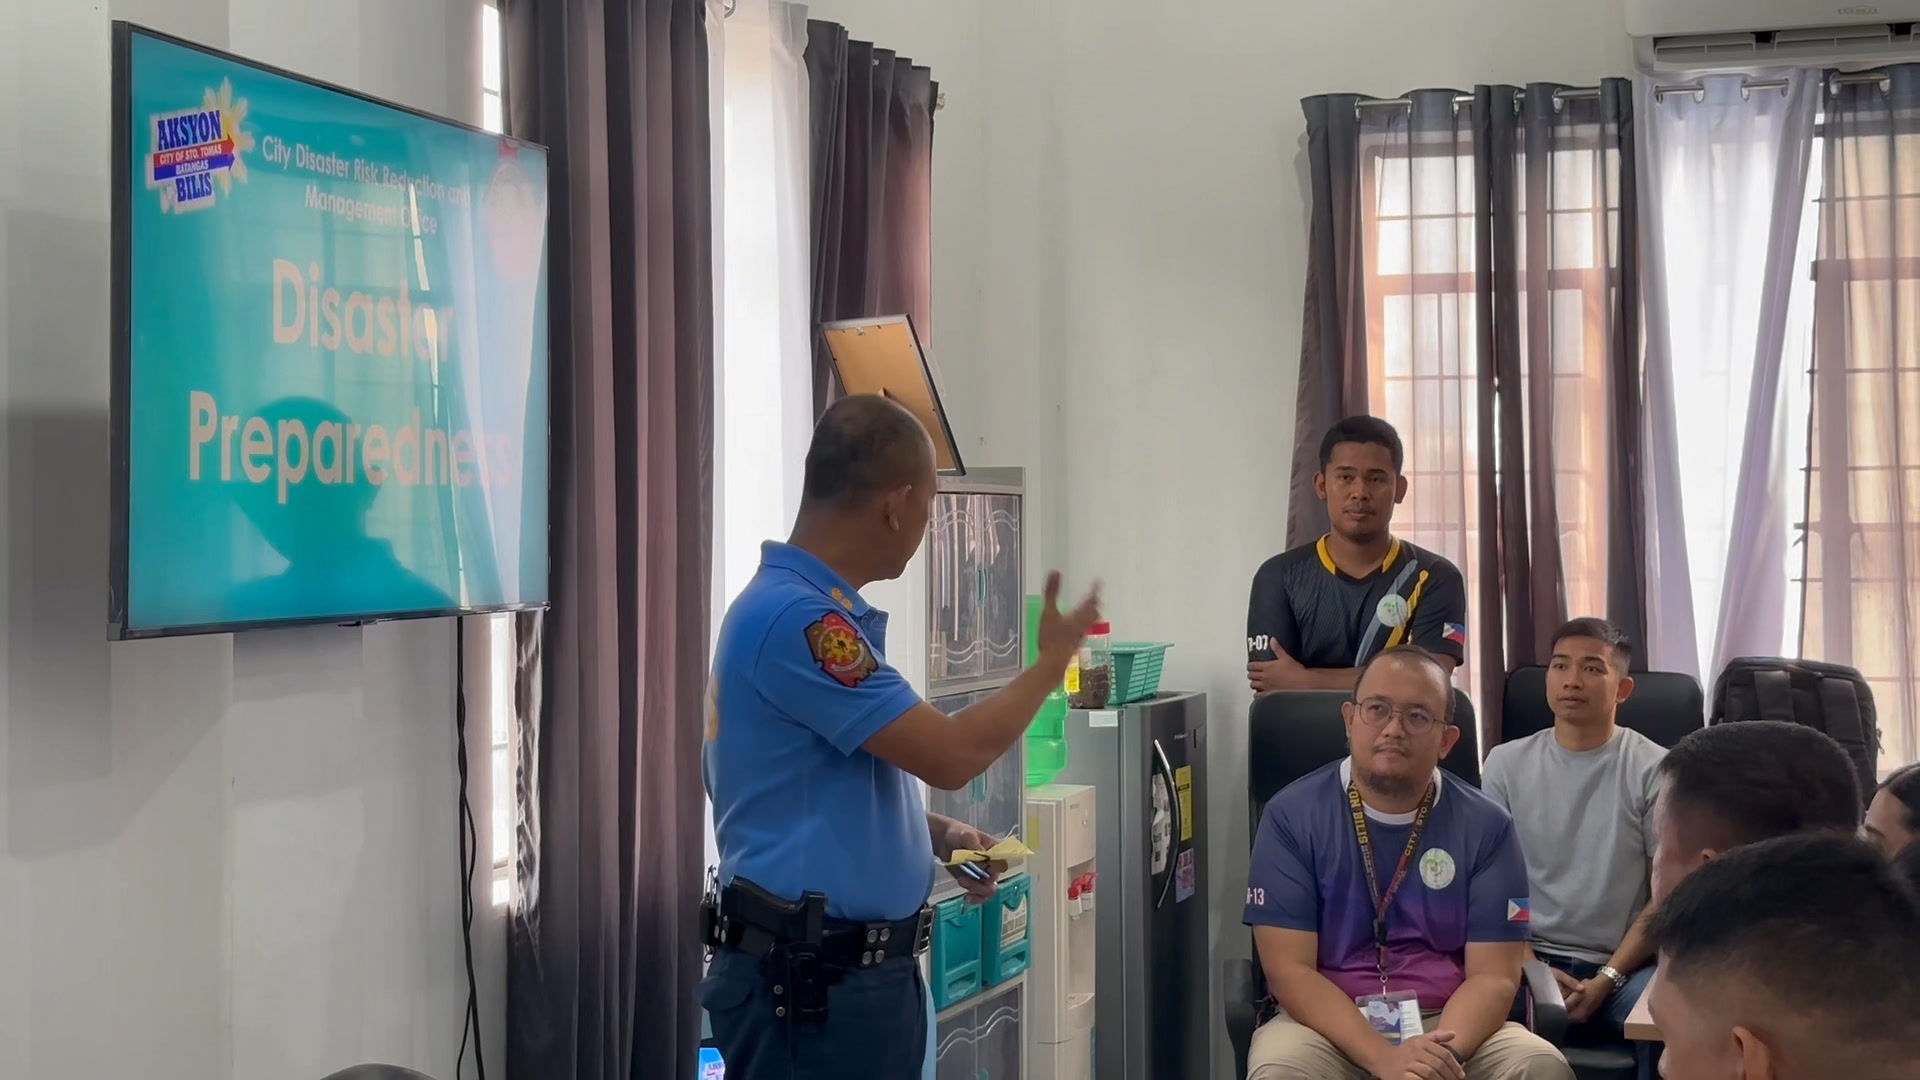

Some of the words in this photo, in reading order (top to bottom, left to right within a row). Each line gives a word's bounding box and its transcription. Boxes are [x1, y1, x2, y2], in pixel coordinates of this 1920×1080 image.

[158, 110, 222, 151] AKSYON
[160, 153, 175, 165] CITY
[176, 152, 185, 162] OF
[200, 143, 222, 156] TOMAS
[175, 159, 209, 175] BATANGAS
[262, 135, 292, 170] City
[296, 143, 350, 178] Disaster
[354, 158, 379, 186] Risk
[383, 165, 445, 199] Reduction
[447, 182, 471, 208] and
[175, 172, 213, 202] BILIS
[305, 184, 397, 223] Management
[401, 205, 438, 234] Oce
[273, 258, 455, 362] Disaster
[189, 389, 514, 504] Preparedness
[1352, 811, 1369, 844] BILIS
[1404, 831, 1418, 856] CITY
